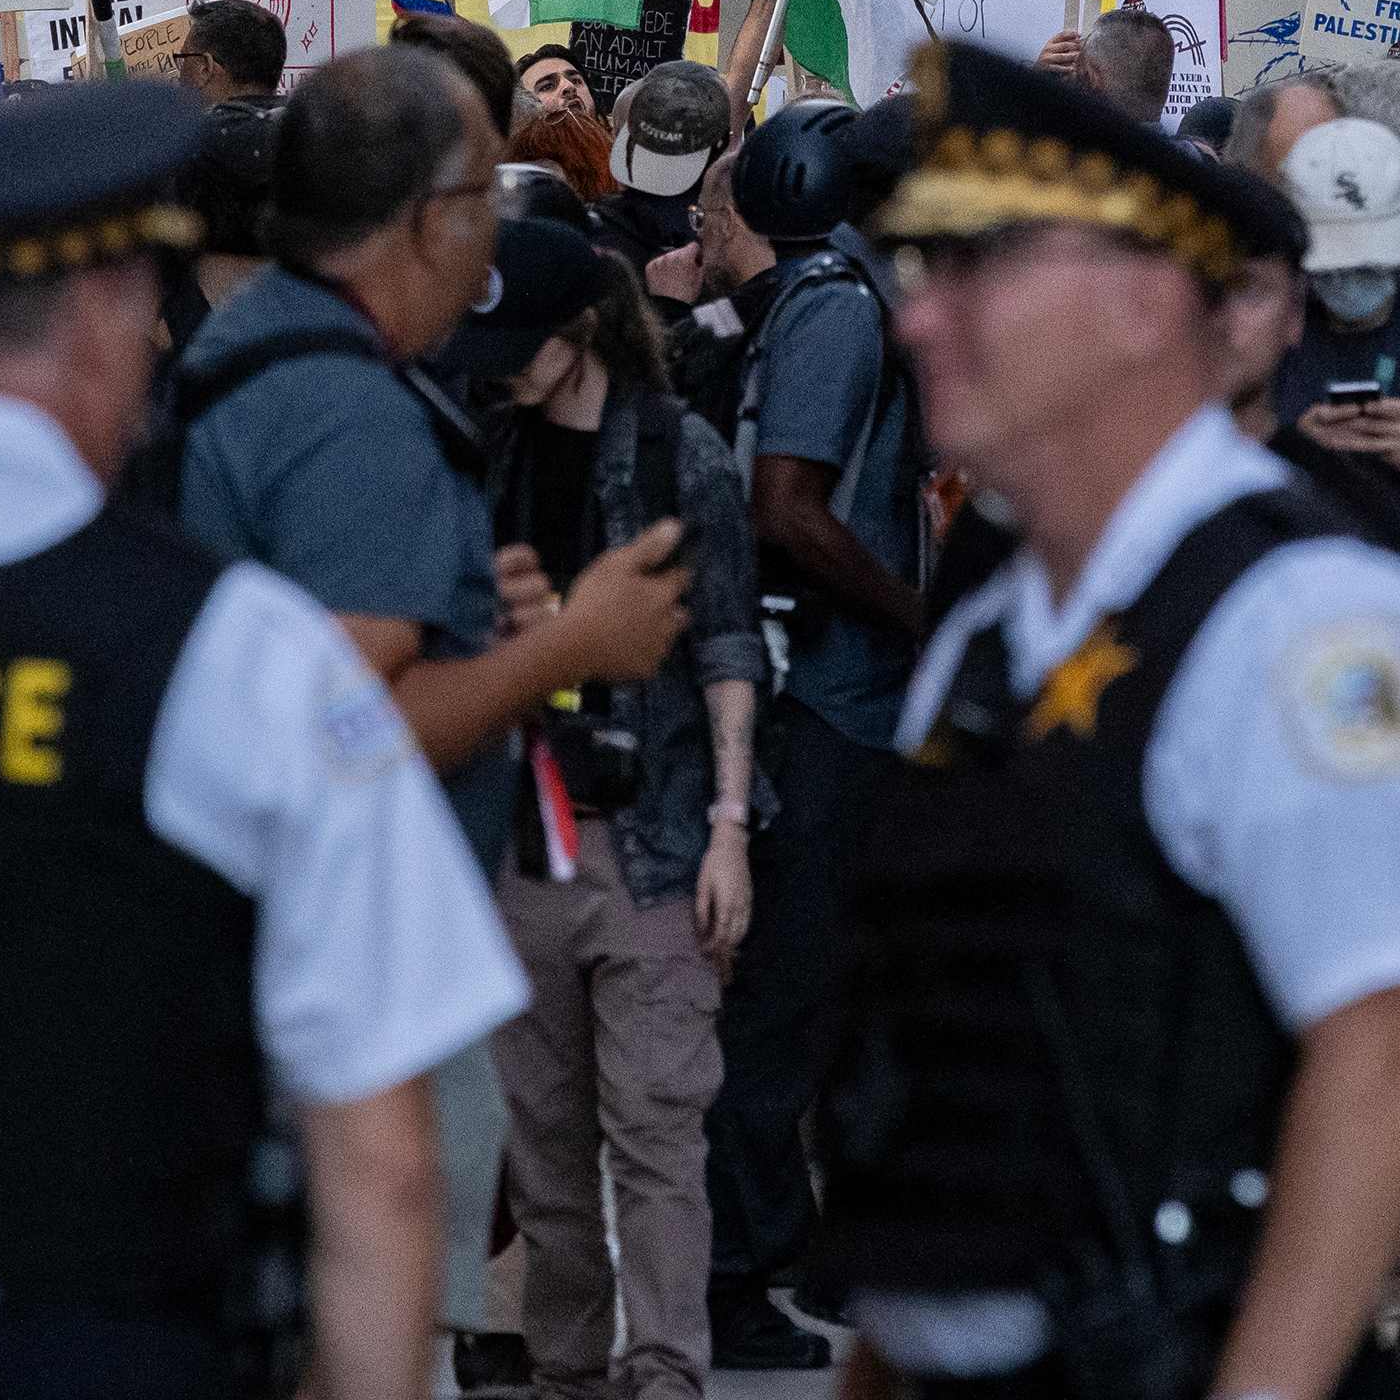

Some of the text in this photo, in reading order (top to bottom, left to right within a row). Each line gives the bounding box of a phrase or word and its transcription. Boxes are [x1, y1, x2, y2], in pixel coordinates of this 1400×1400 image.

[120, 23, 180, 55] EOPLE
[576, 31, 667, 58] AN ADULT
